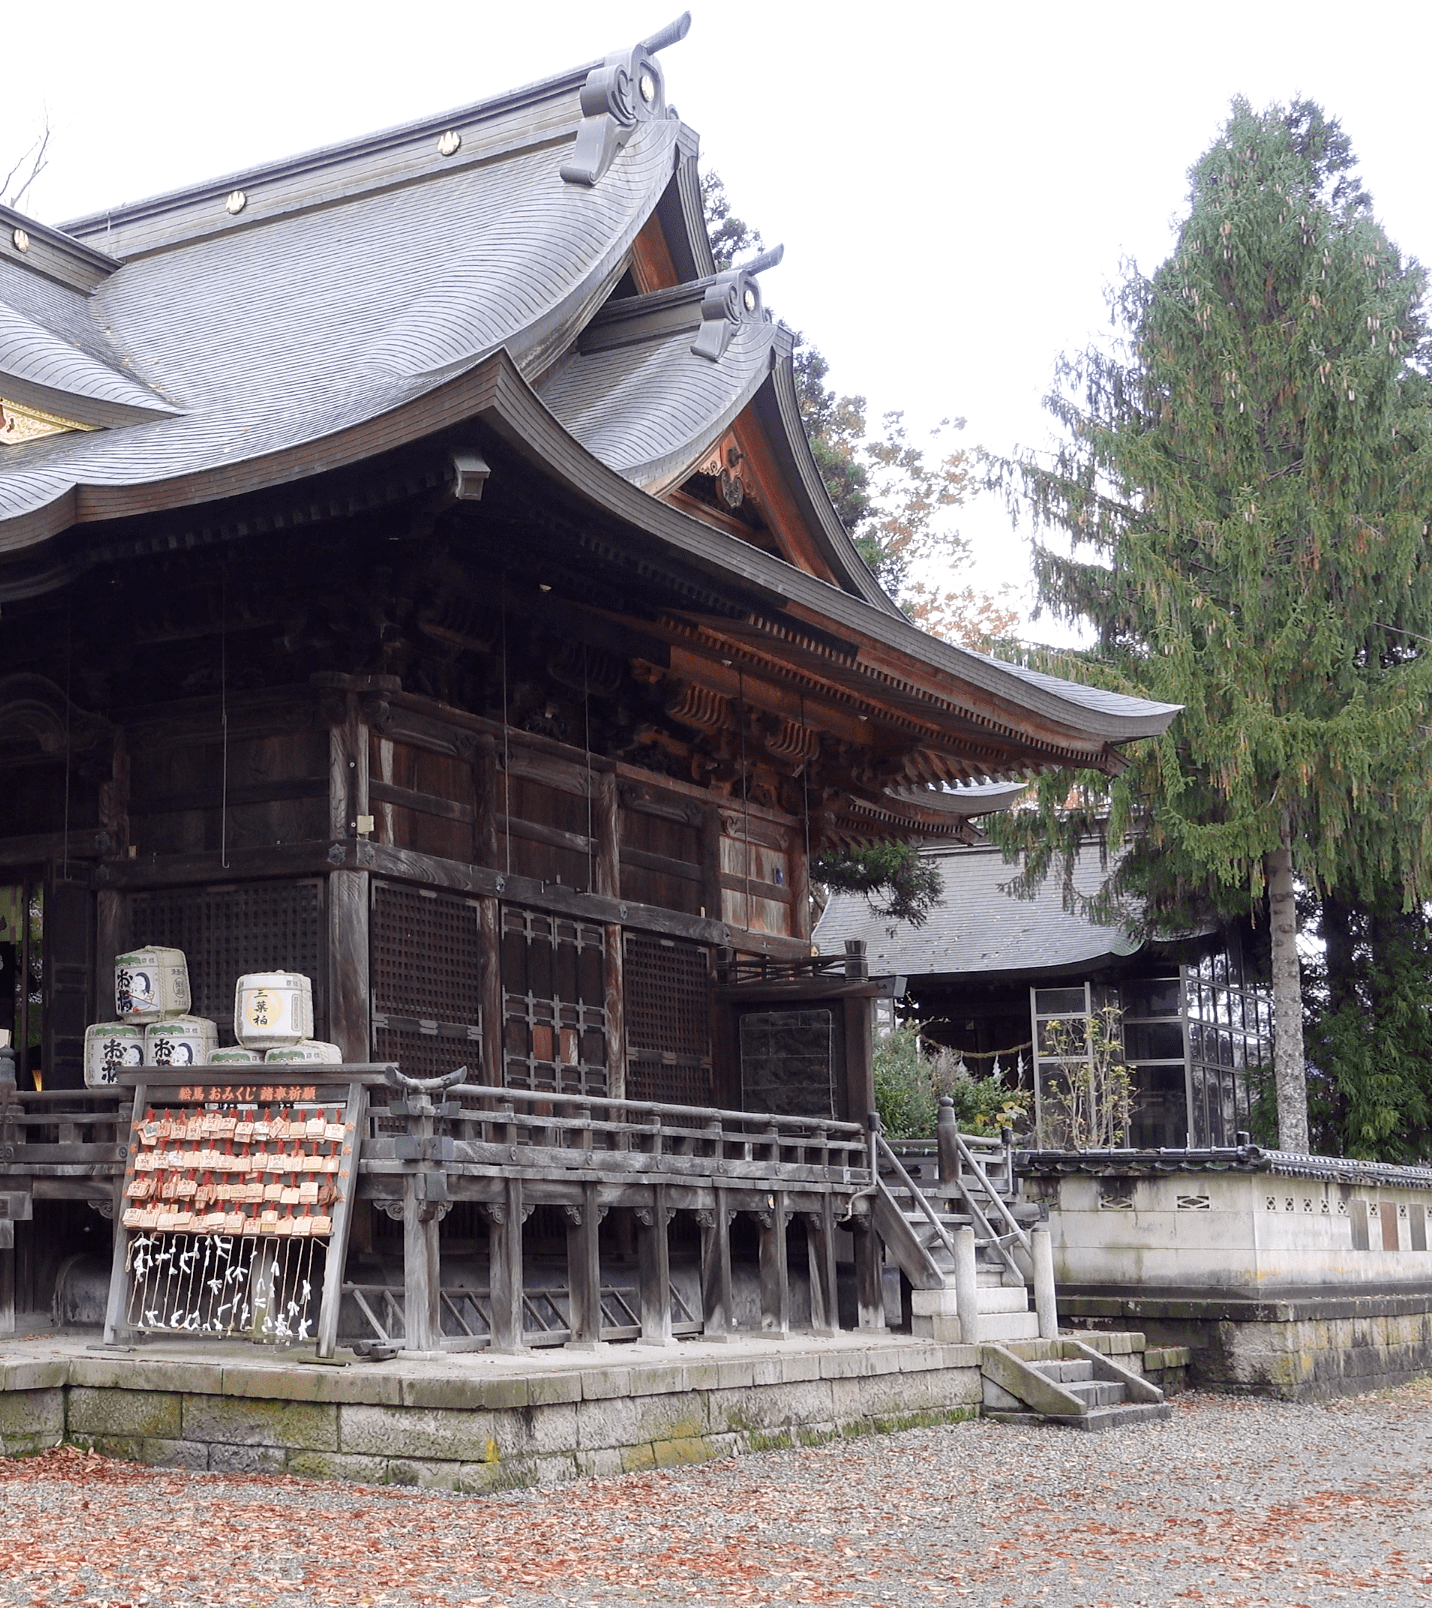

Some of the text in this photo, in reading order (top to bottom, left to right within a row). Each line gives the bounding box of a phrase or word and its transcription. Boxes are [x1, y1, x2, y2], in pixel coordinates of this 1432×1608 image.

[153, 1039, 176, 1067] お
[178, 1086, 317, 1101] 絵馬 おみくじ 諸事祈願
